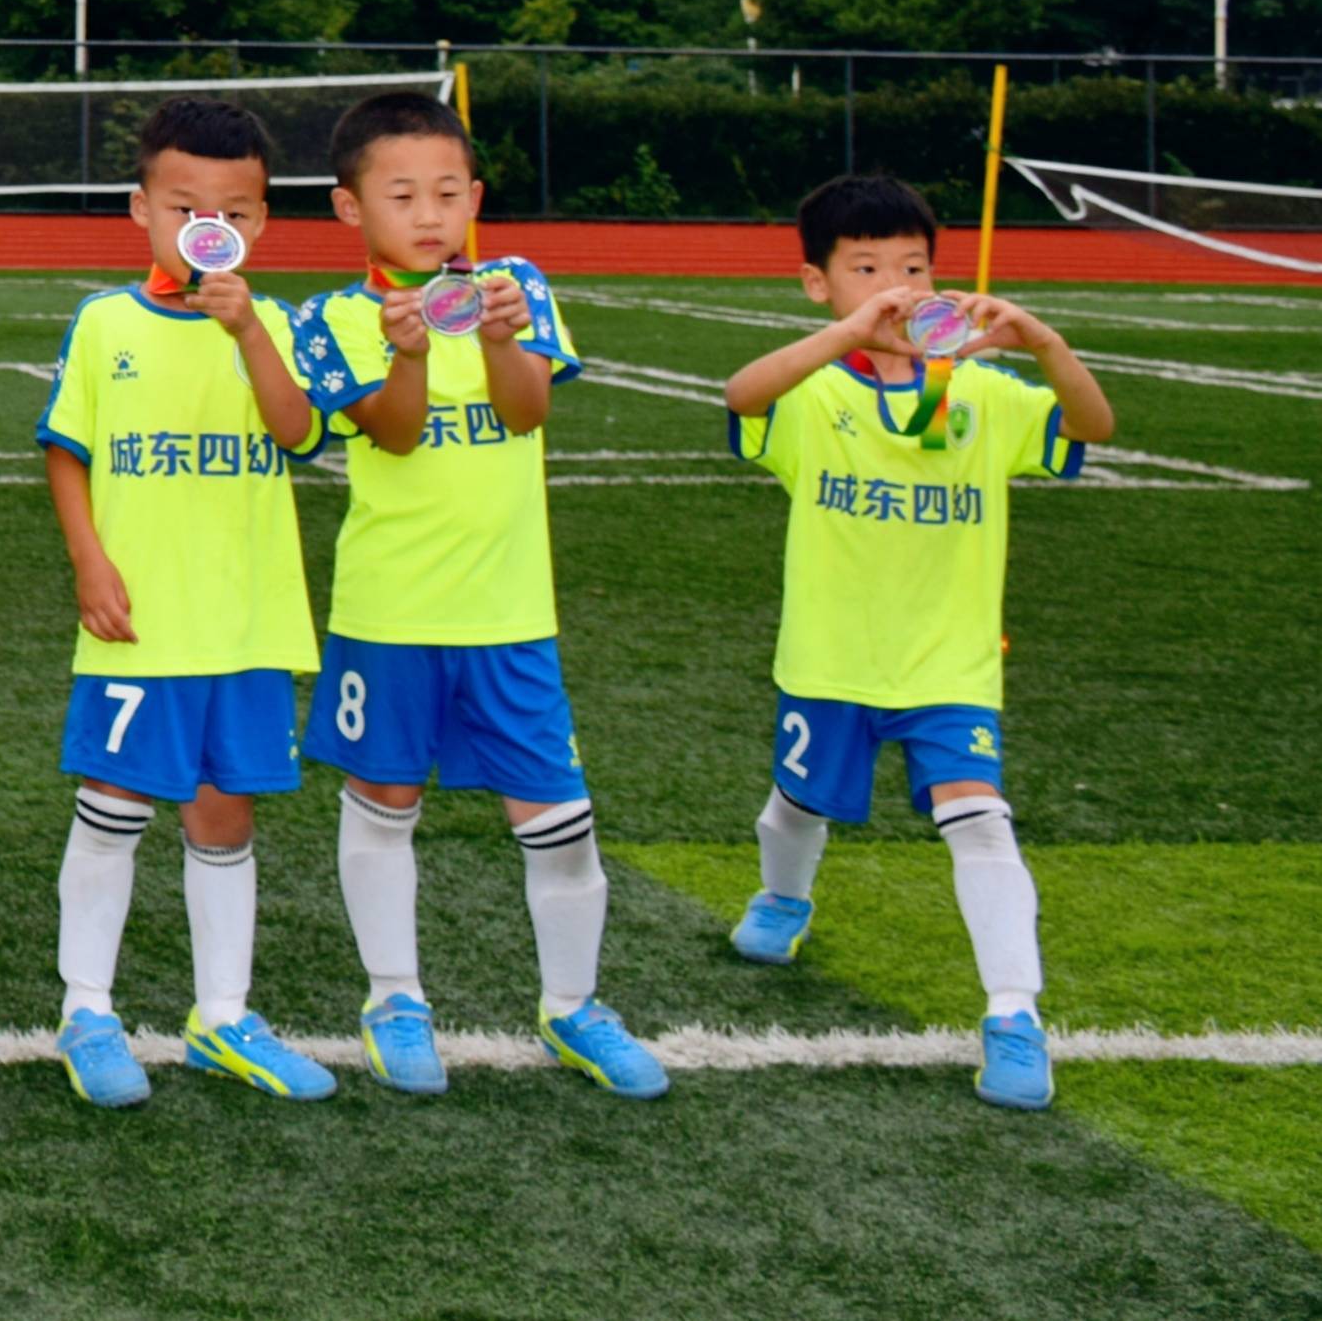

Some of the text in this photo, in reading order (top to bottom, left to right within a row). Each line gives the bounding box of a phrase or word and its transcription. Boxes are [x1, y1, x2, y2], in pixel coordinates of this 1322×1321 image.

[109, 431, 286, 478] 城东四幼
[417, 402, 535, 449] 东四
[815, 469, 984, 525] 城东四幼
[104, 682, 146, 754] 7
[336, 671, 366, 741] 8
[782, 711, 811, 779] 2
